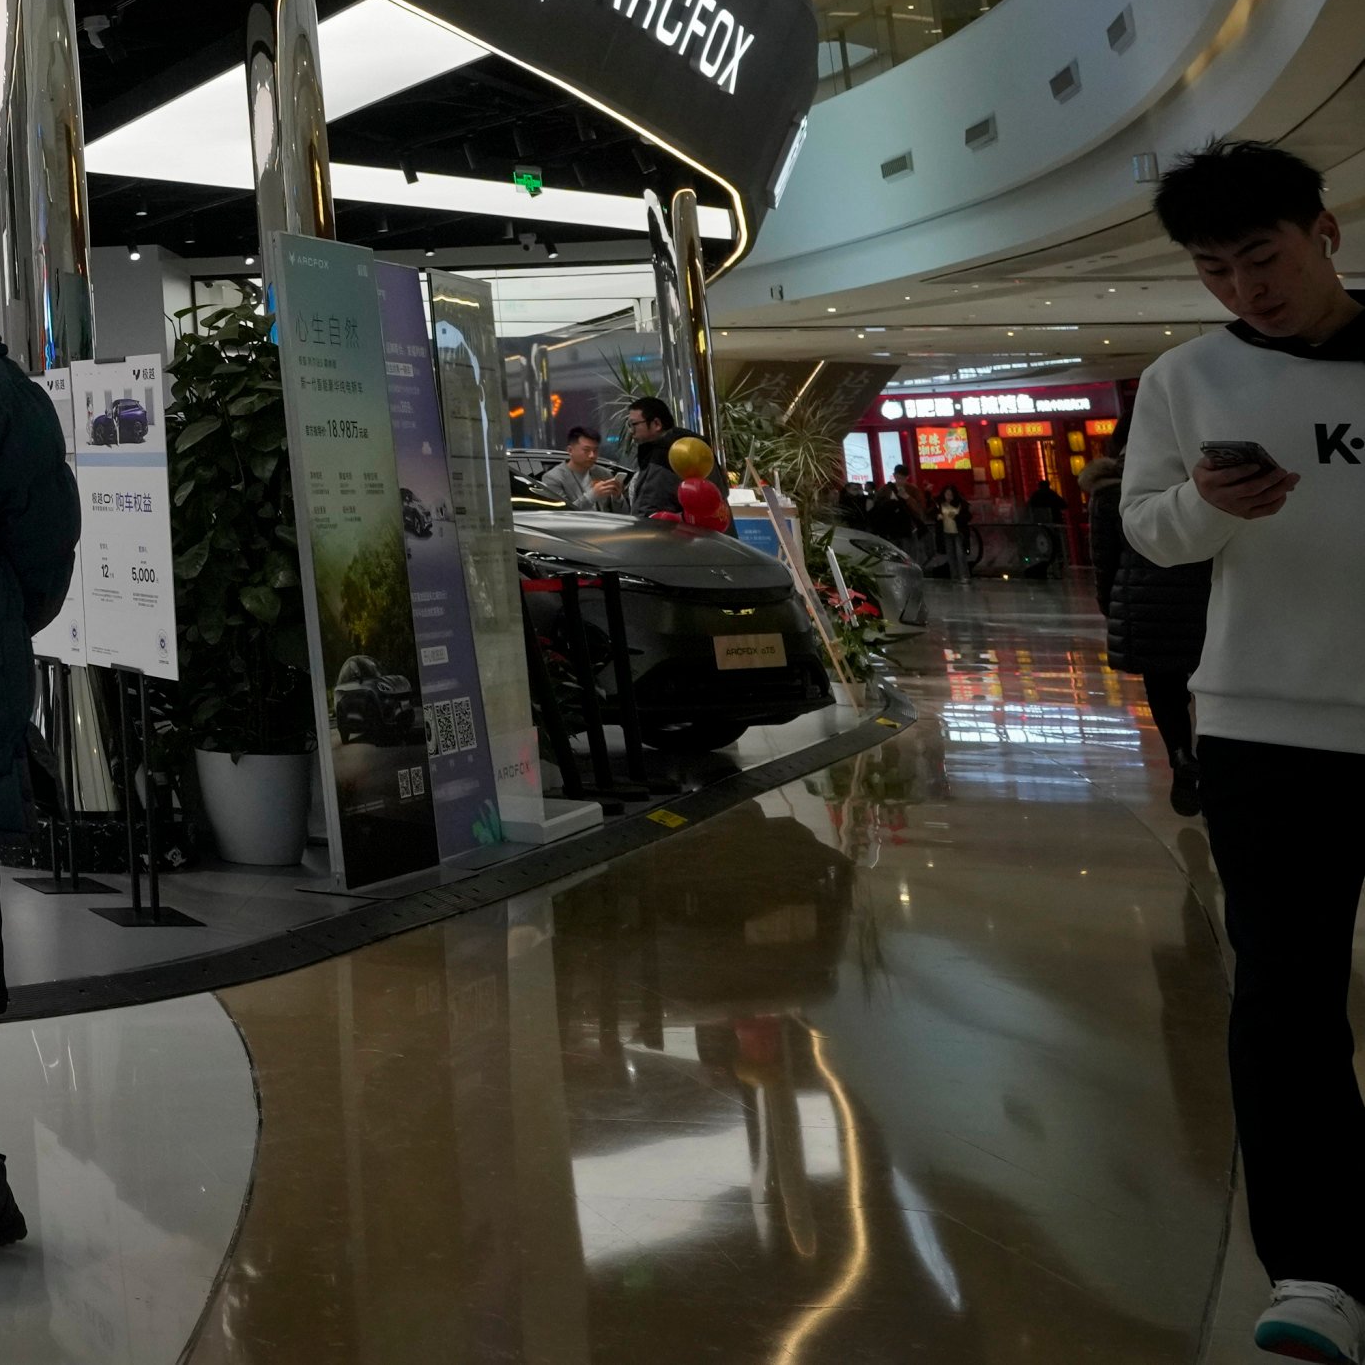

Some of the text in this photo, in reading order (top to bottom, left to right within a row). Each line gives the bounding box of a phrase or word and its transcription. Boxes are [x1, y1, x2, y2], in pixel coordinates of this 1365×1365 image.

[296, 255, 330, 270] ARCFOX
[295, 310, 360, 348] 心生自然
[115, 491, 153, 513] 购车权益
[131, 566, 156, 584] 5,000
[497, 761, 530, 782] ARCFOX
